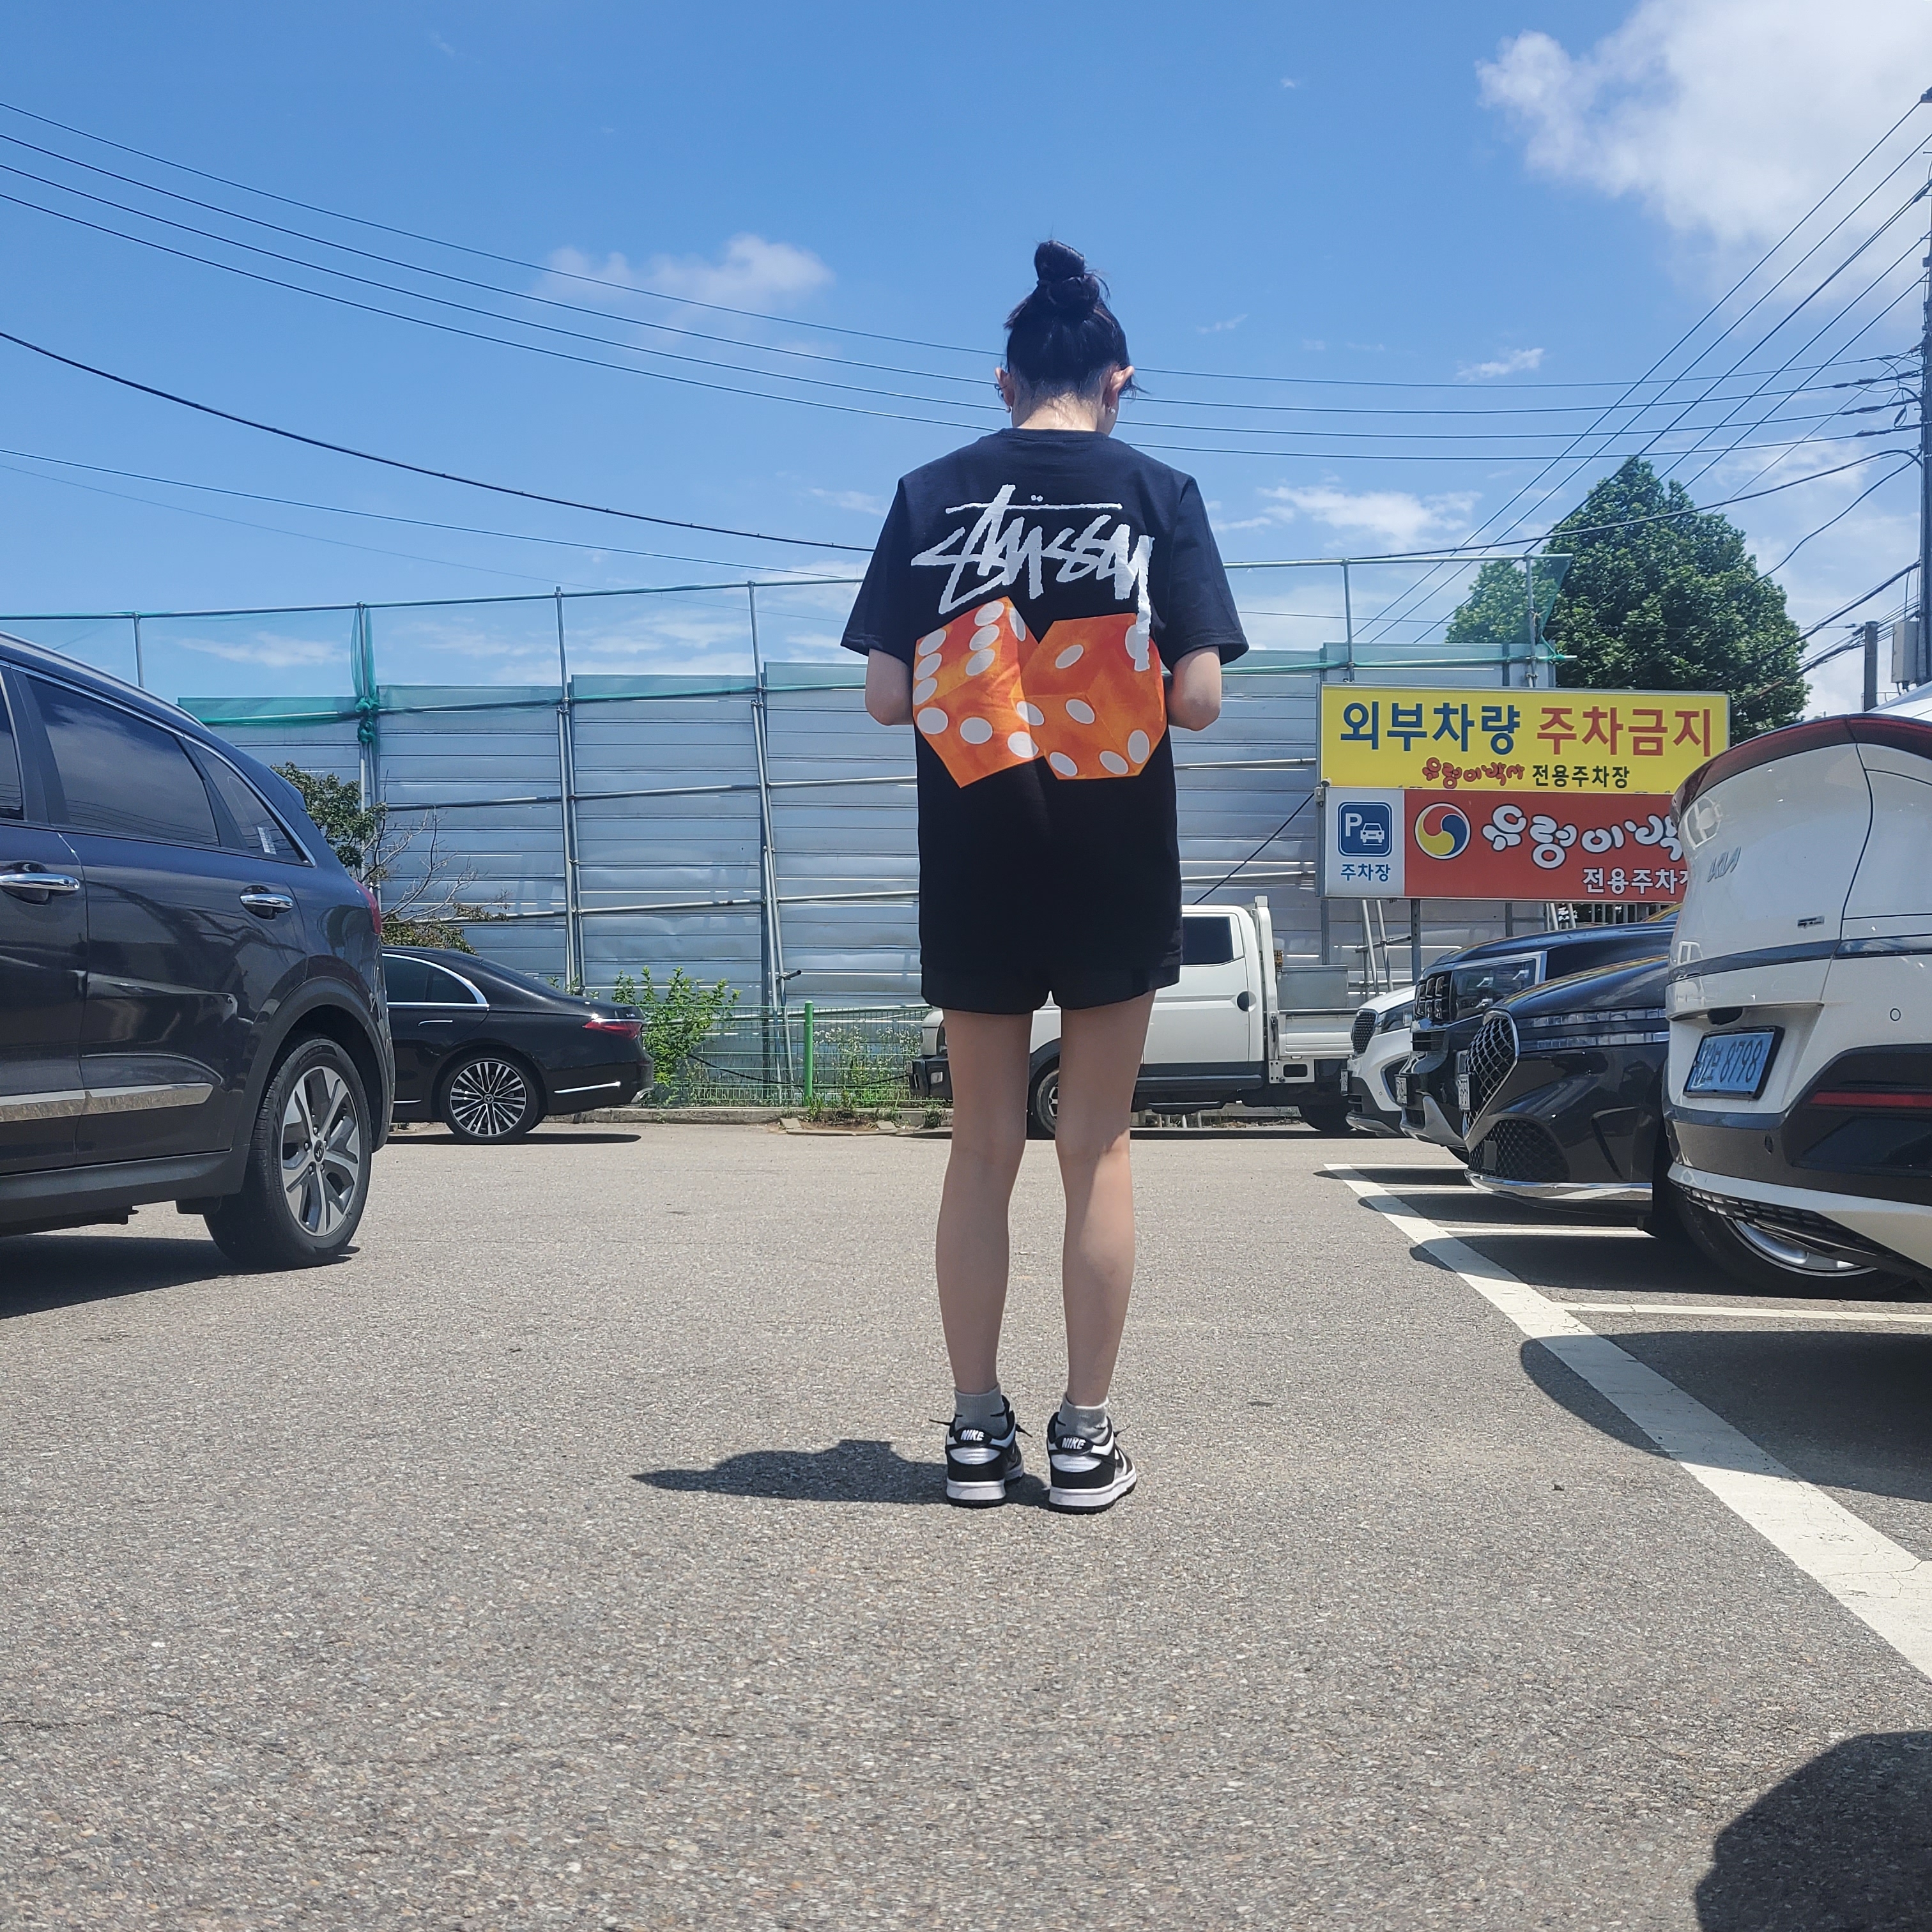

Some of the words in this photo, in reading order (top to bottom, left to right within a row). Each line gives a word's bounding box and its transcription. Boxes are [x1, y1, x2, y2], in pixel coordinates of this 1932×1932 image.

[1340, 702, 1520, 755] 외부차량
[1537, 706, 1712, 756] 주차금지
[1532, 764, 1630, 788] 전용주차장
[1345, 813, 1363, 837] P
[1340, 863, 1391, 882] 주차장
[1720, 1039, 1763, 1083] 8798
[960, 1429, 985, 1441] NIKE
[1062, 1438, 1085, 1450] NIKE
